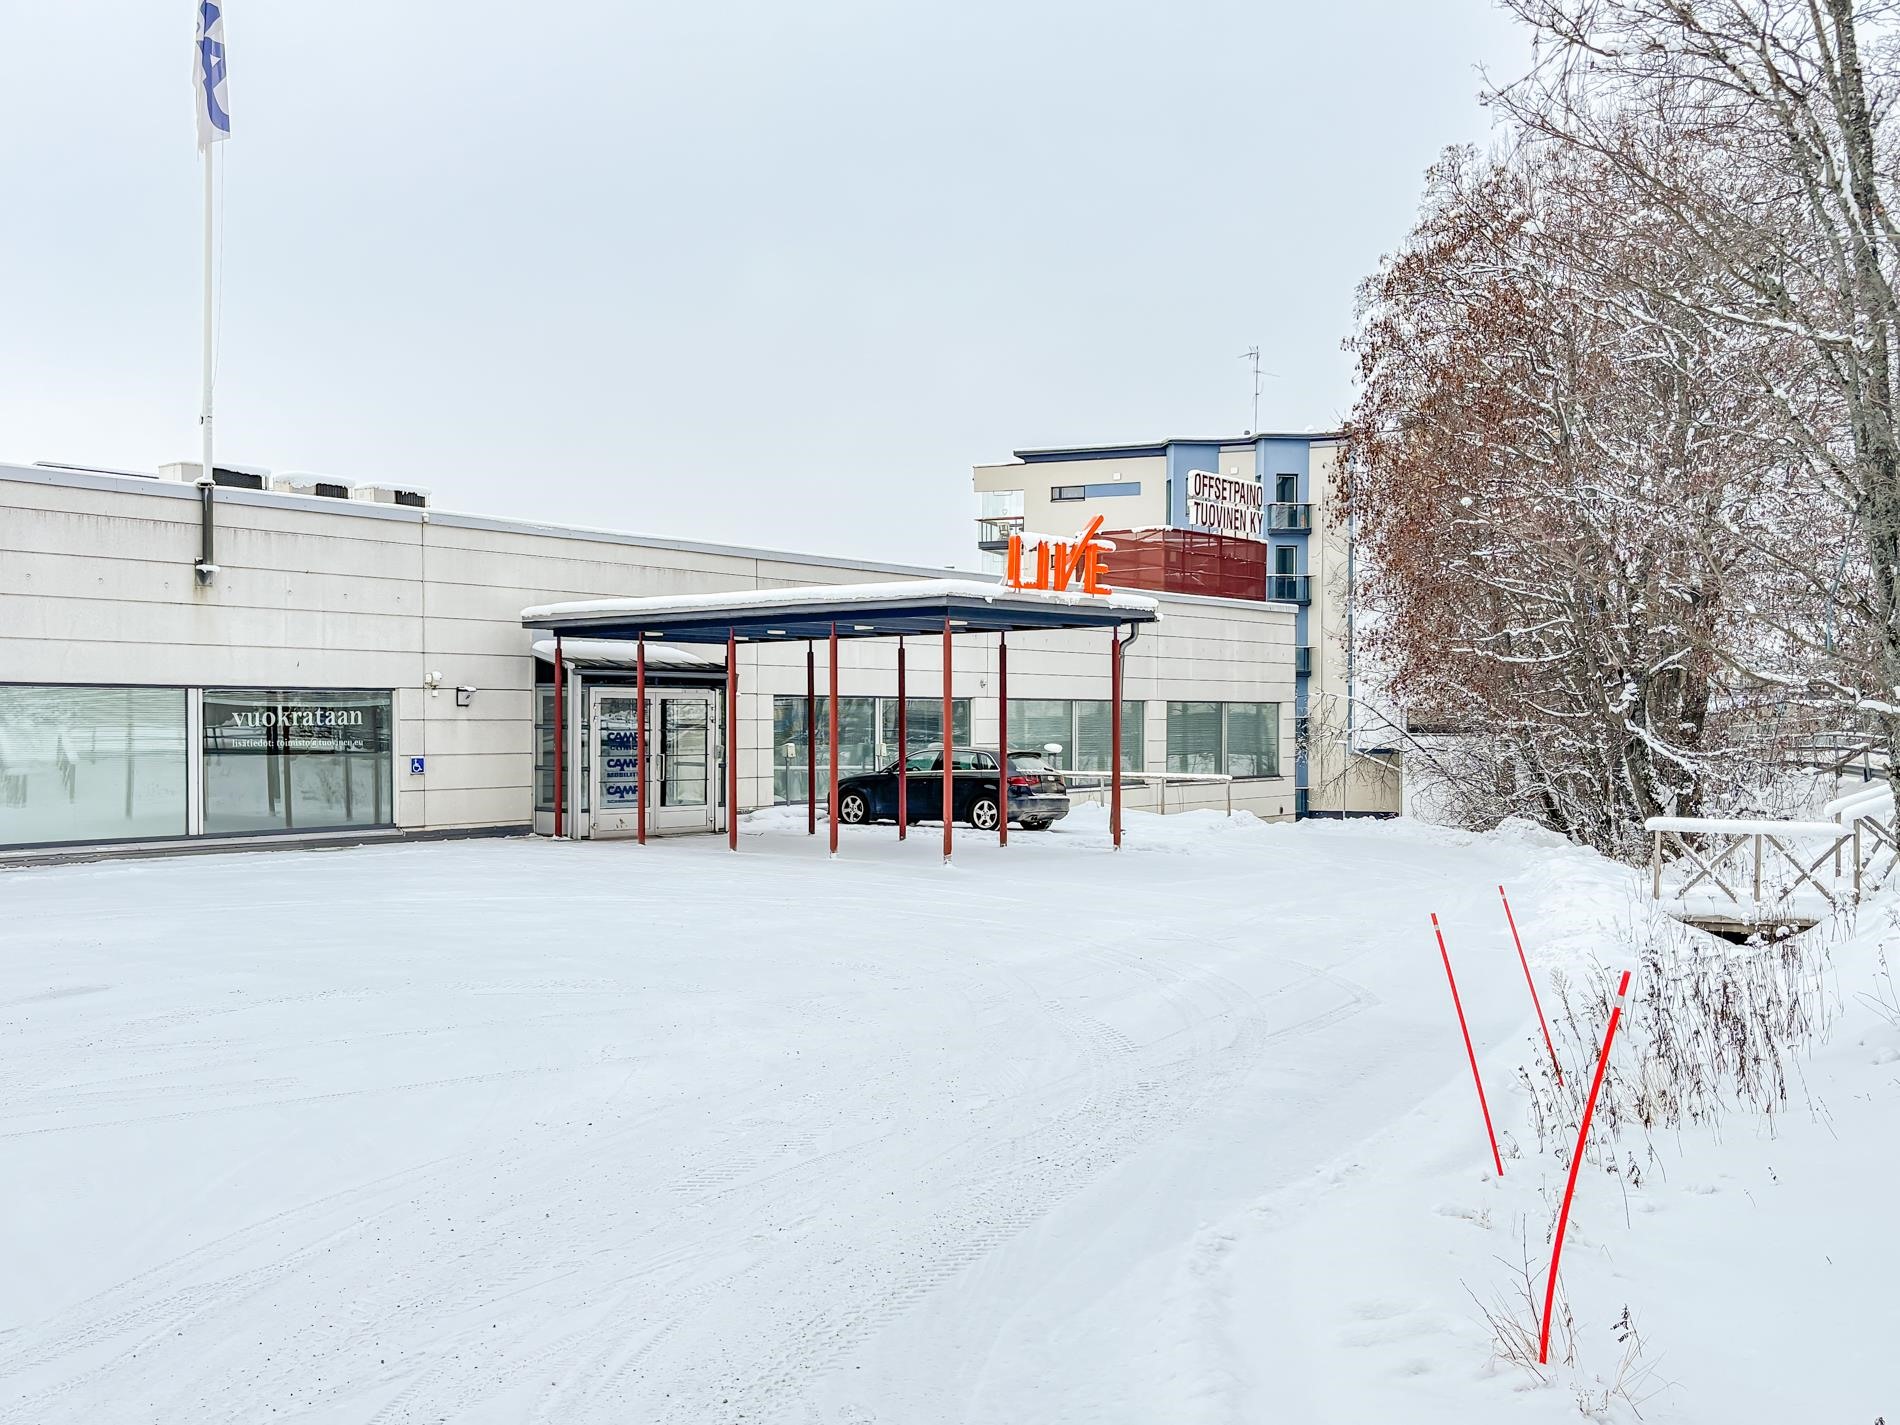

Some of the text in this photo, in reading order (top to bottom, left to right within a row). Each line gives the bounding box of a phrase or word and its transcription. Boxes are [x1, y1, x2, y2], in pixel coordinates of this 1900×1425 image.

[1194, 473, 1263, 508] OFFSETPAINO
[1194, 501, 1264, 535] TUOVINEN KY
[1007, 514, 1114, 595] LIVE
[232, 706, 363, 727] vuokrataan
[232, 738, 275, 748] lisätiedot:
